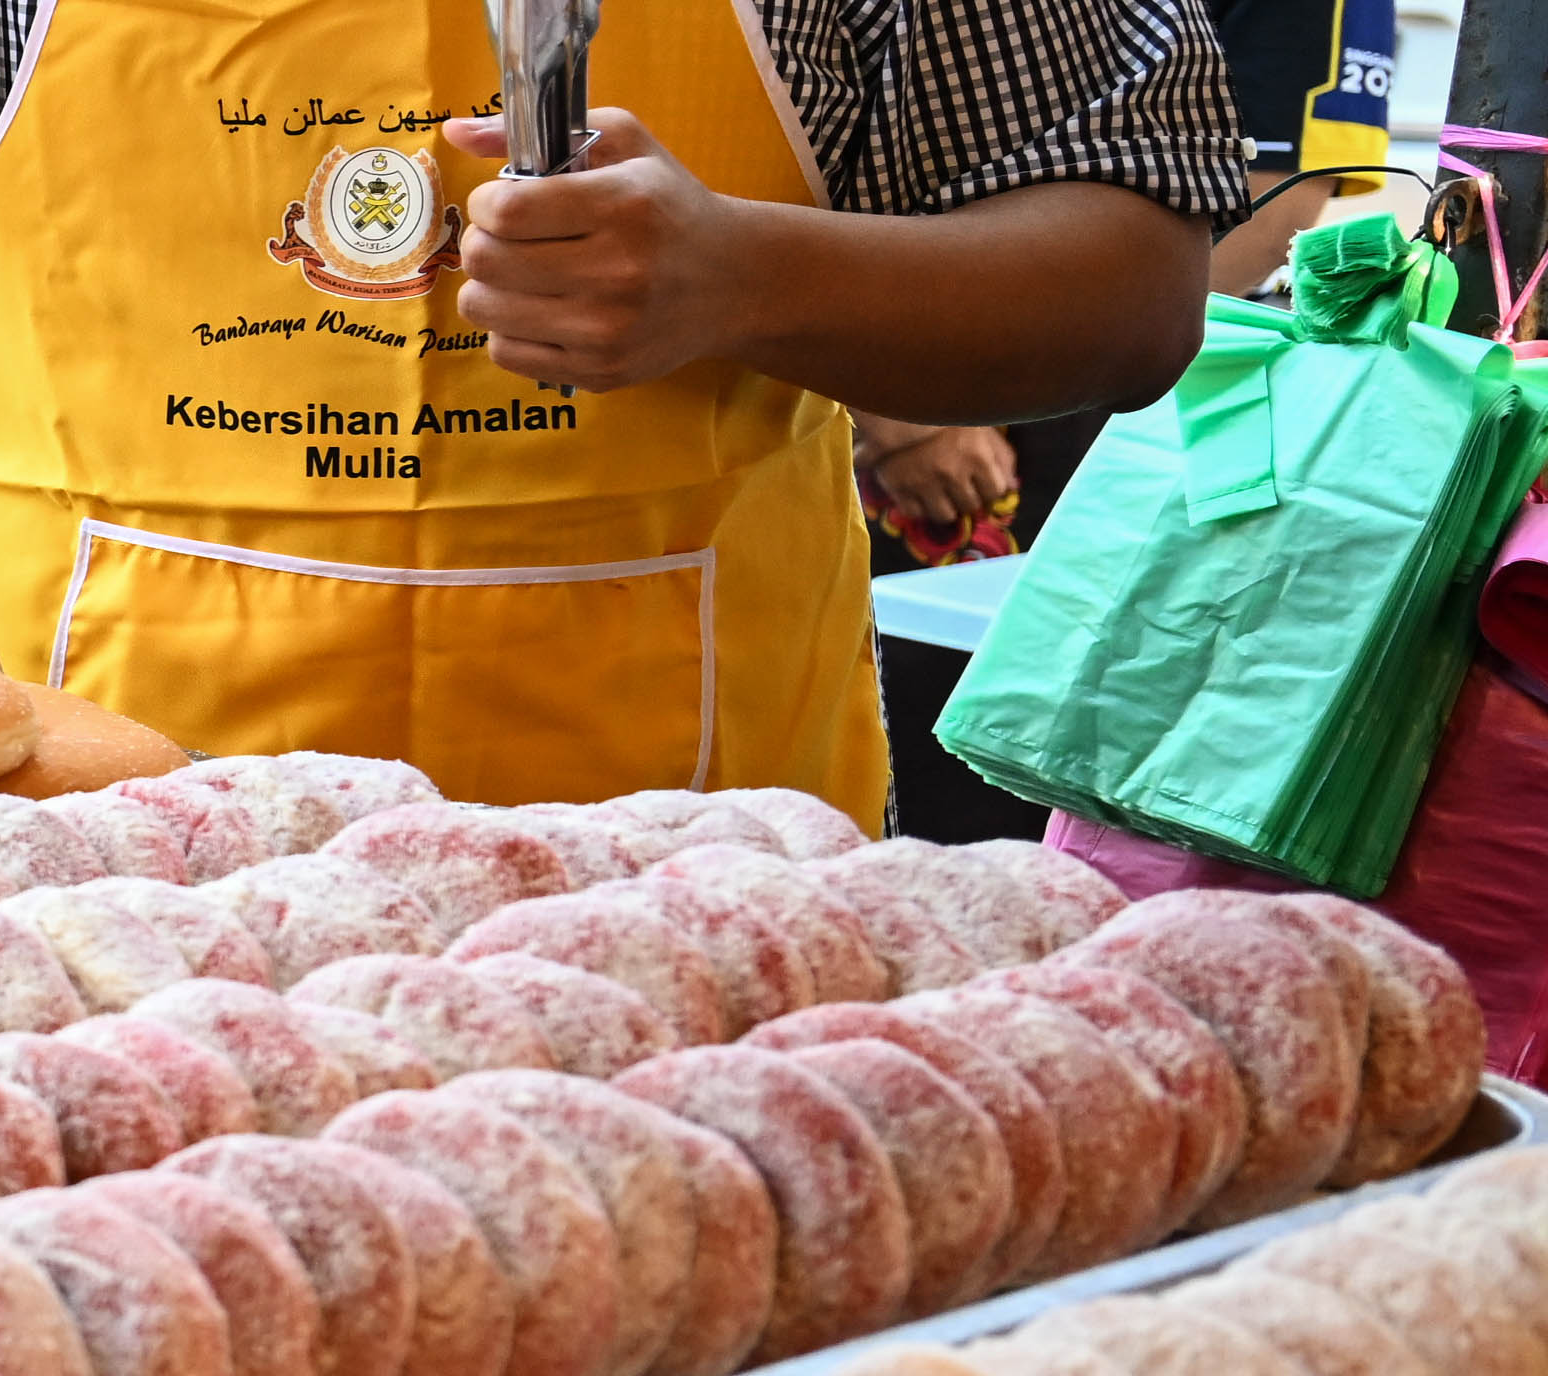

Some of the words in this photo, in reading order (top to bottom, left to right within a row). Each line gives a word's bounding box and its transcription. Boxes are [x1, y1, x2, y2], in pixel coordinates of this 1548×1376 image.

[1339, 62, 1396, 98] 20
[192, 315, 306, 348] Bandaraya
[314, 309, 407, 349] Warisan
[165, 394, 399, 436] Kebersihan
[411, 399, 577, 435] Amalan
[305, 445, 422, 480] Mulia
